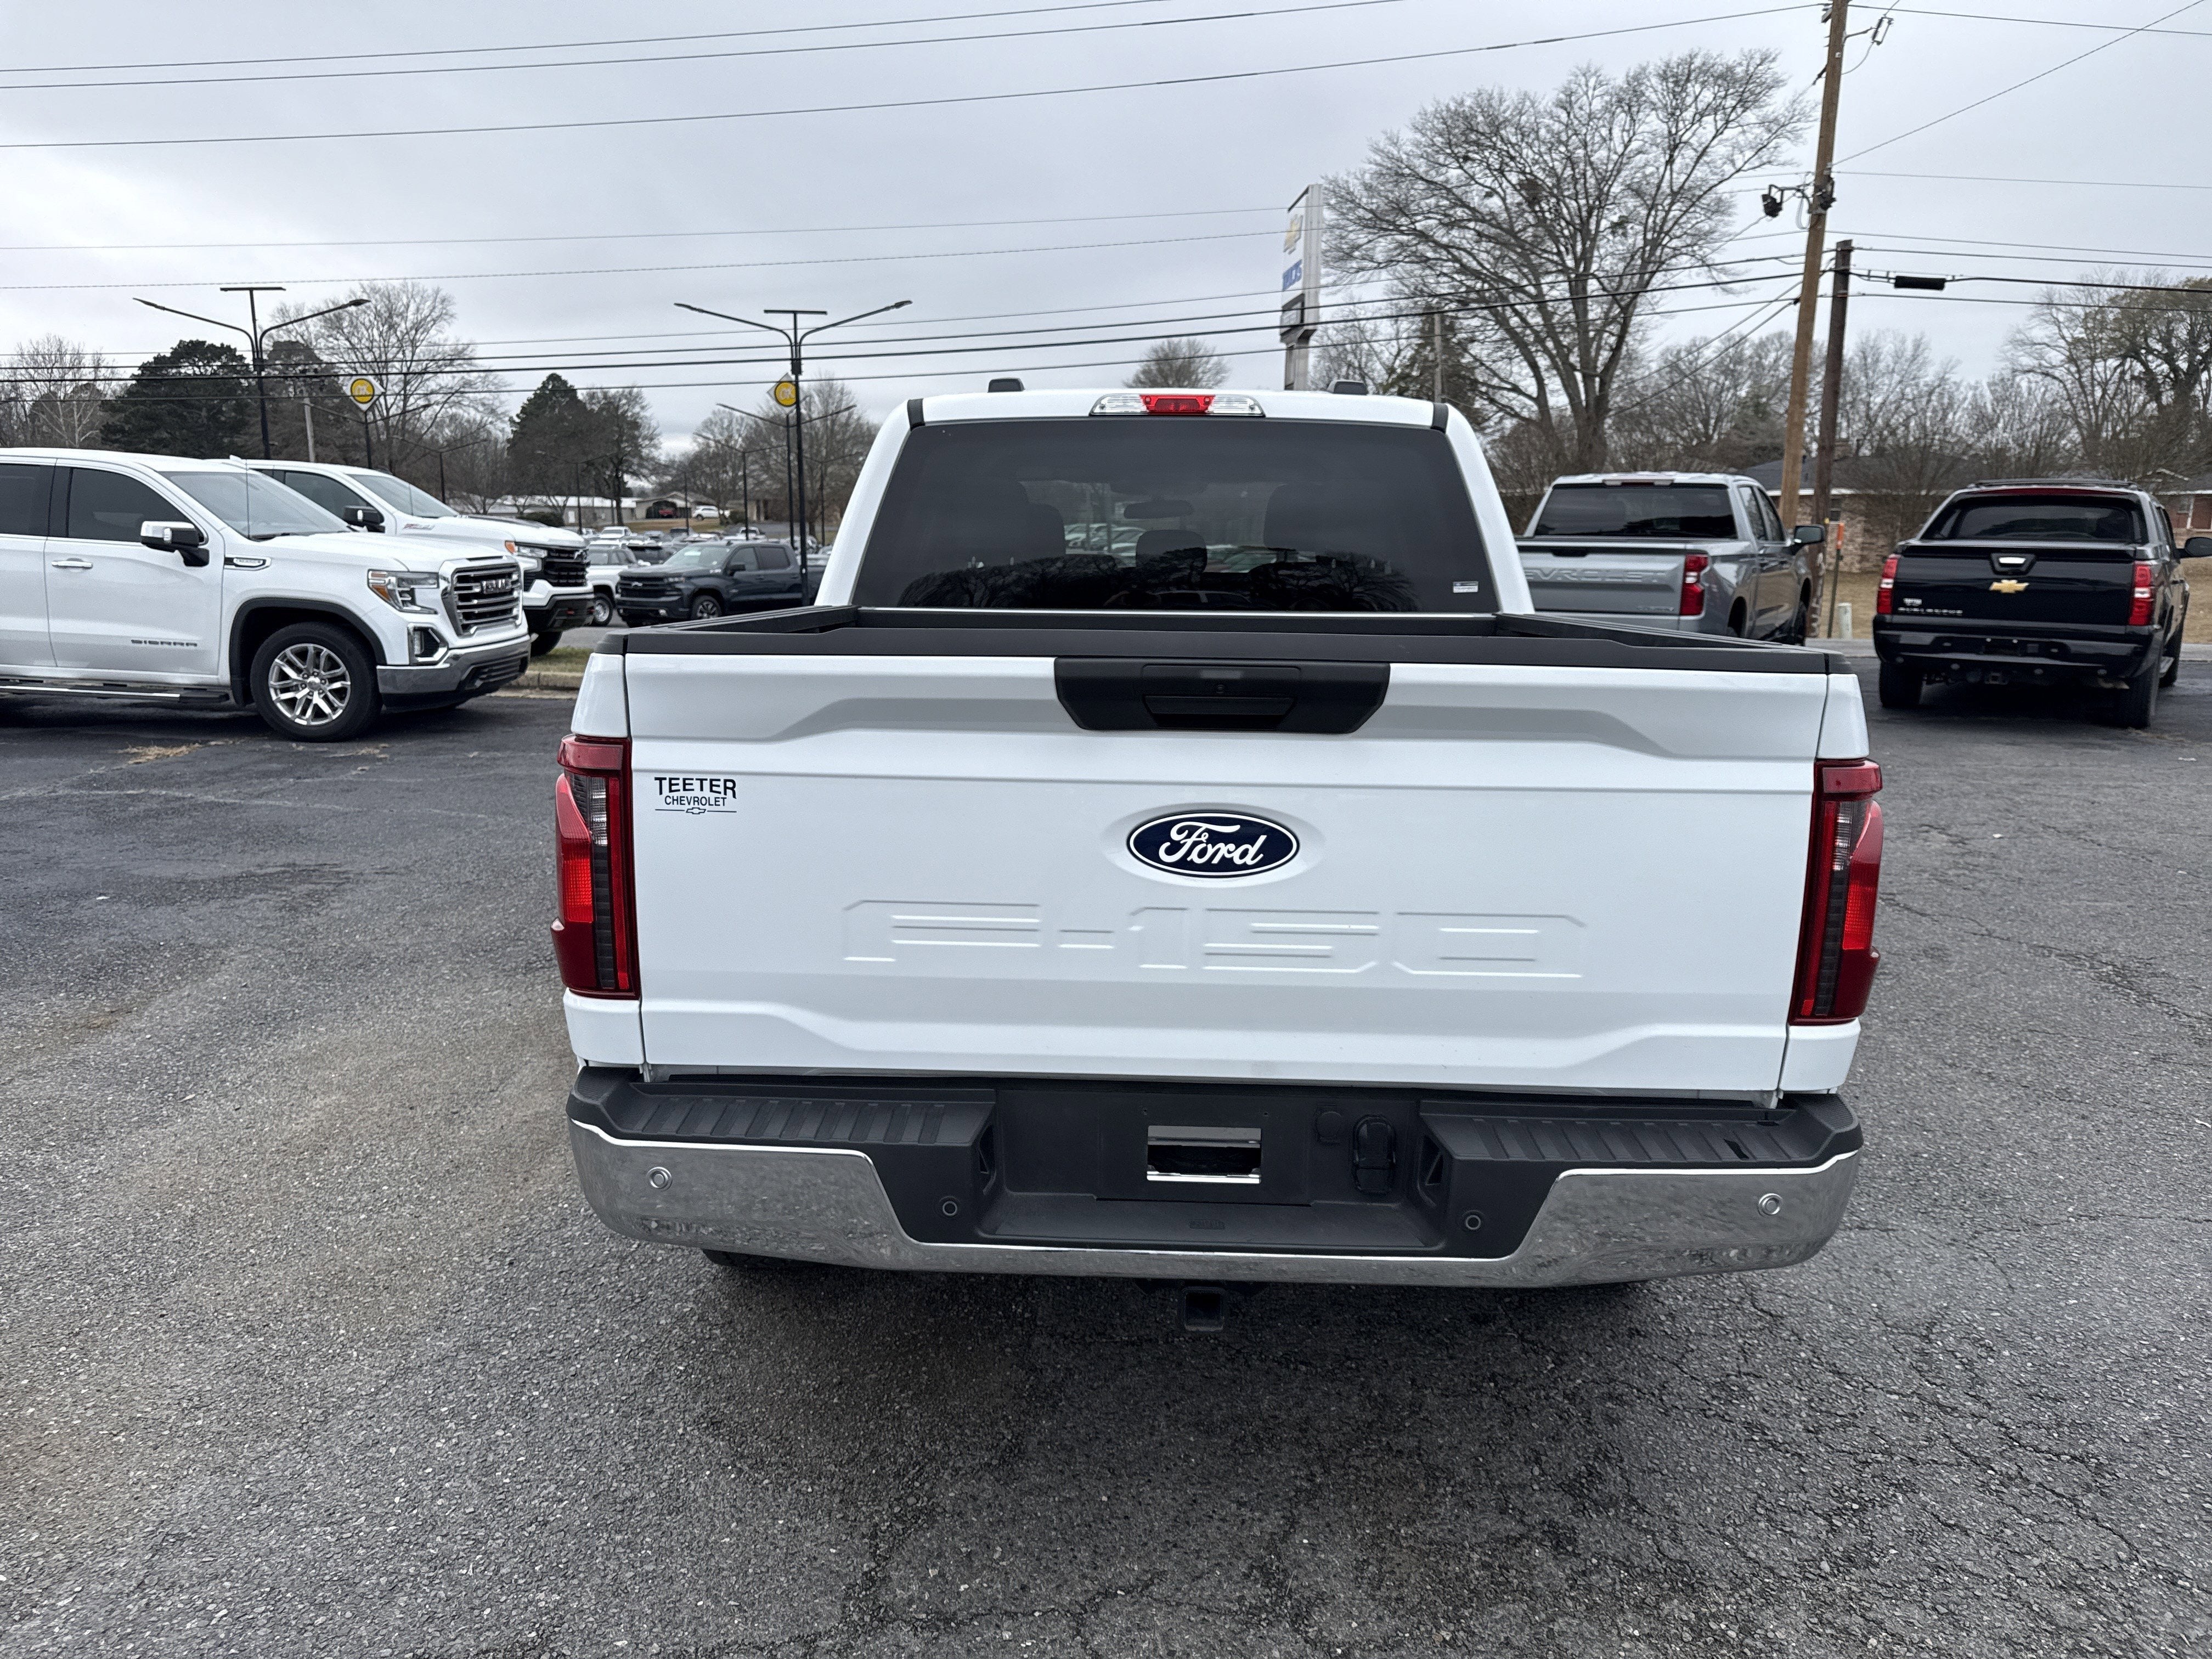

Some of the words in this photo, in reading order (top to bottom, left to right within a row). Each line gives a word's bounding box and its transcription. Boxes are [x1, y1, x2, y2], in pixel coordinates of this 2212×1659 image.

[654, 777, 737, 799] TEETER
[664, 795, 727, 806] CHEVROLET
[1158, 821, 1267, 865] Ford
